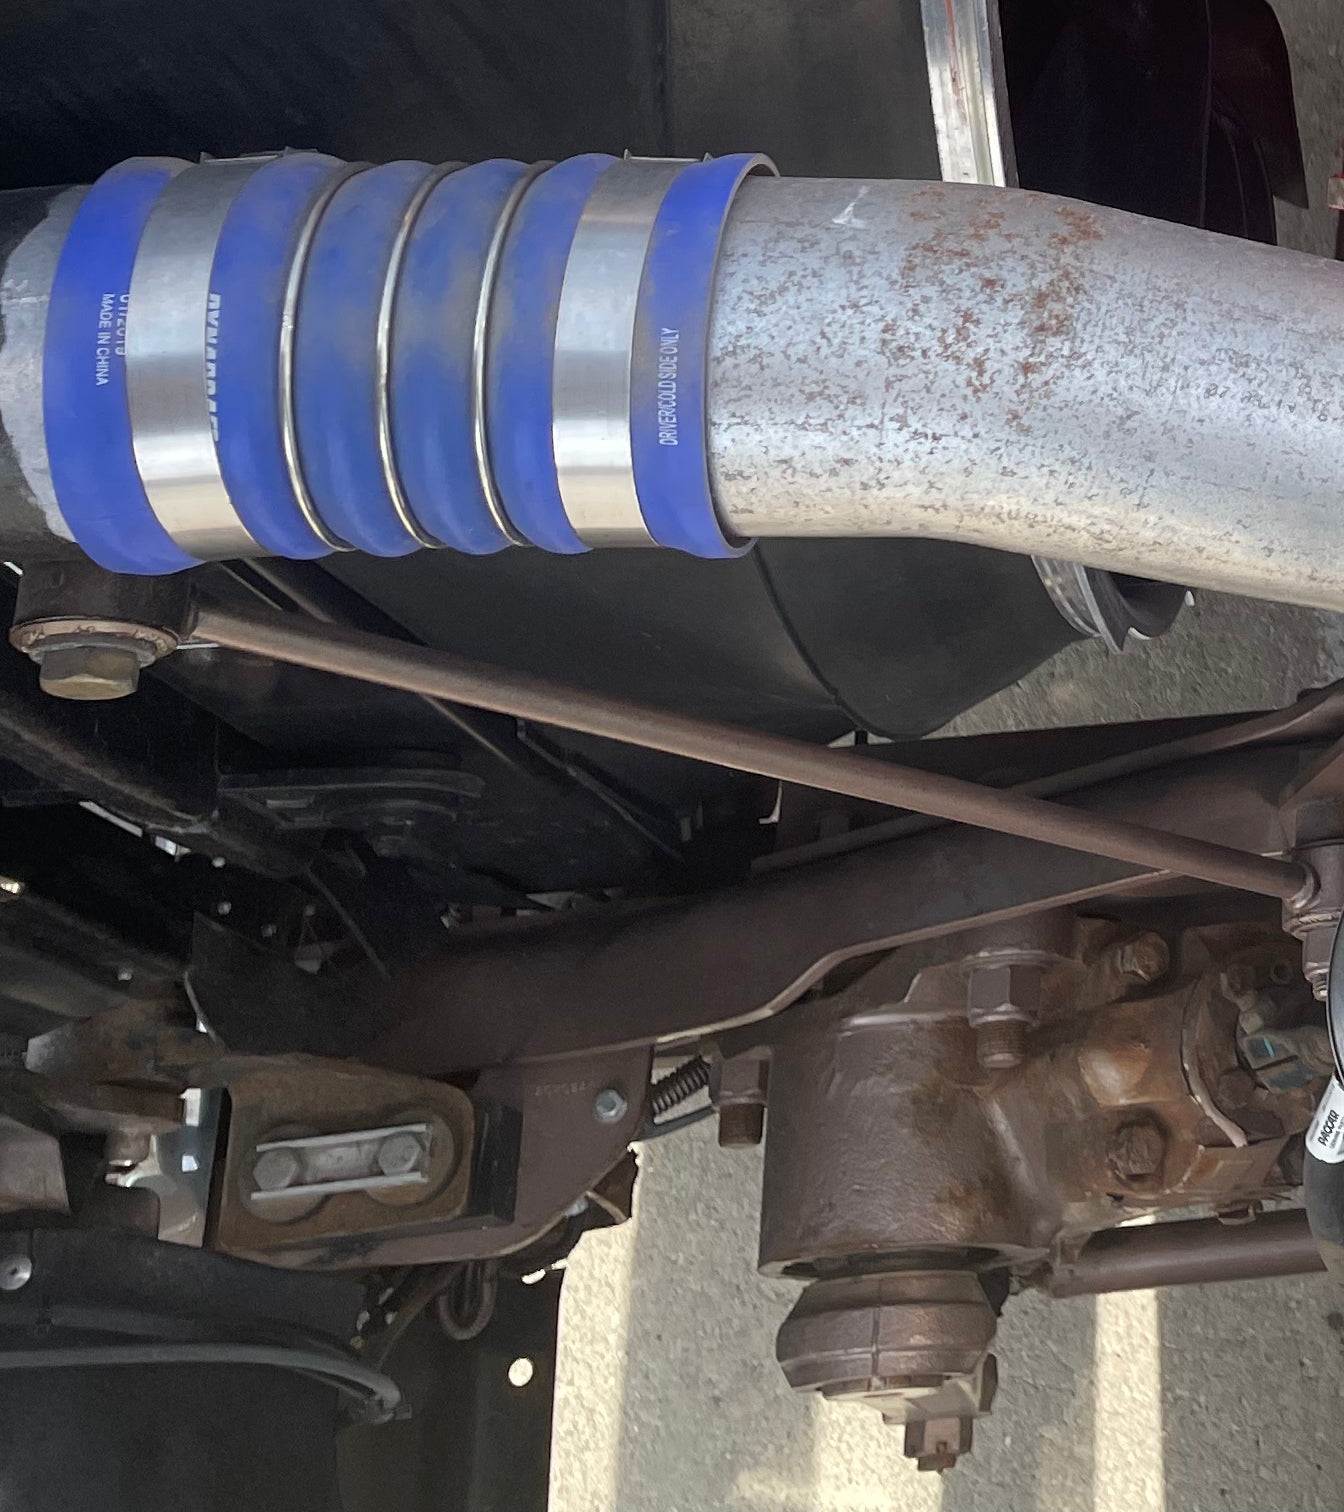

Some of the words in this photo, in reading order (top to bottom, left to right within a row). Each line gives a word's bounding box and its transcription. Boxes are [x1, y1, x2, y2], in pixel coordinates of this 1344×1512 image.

[97, 293, 116, 329] MADE
[97, 331, 111, 345] IN
[660, 327, 679, 355] ONLY
[95, 346, 110, 386] CHINA
[658, 356, 678, 380] SIDE
[1317, 1109, 1340, 1147] PACCAR
